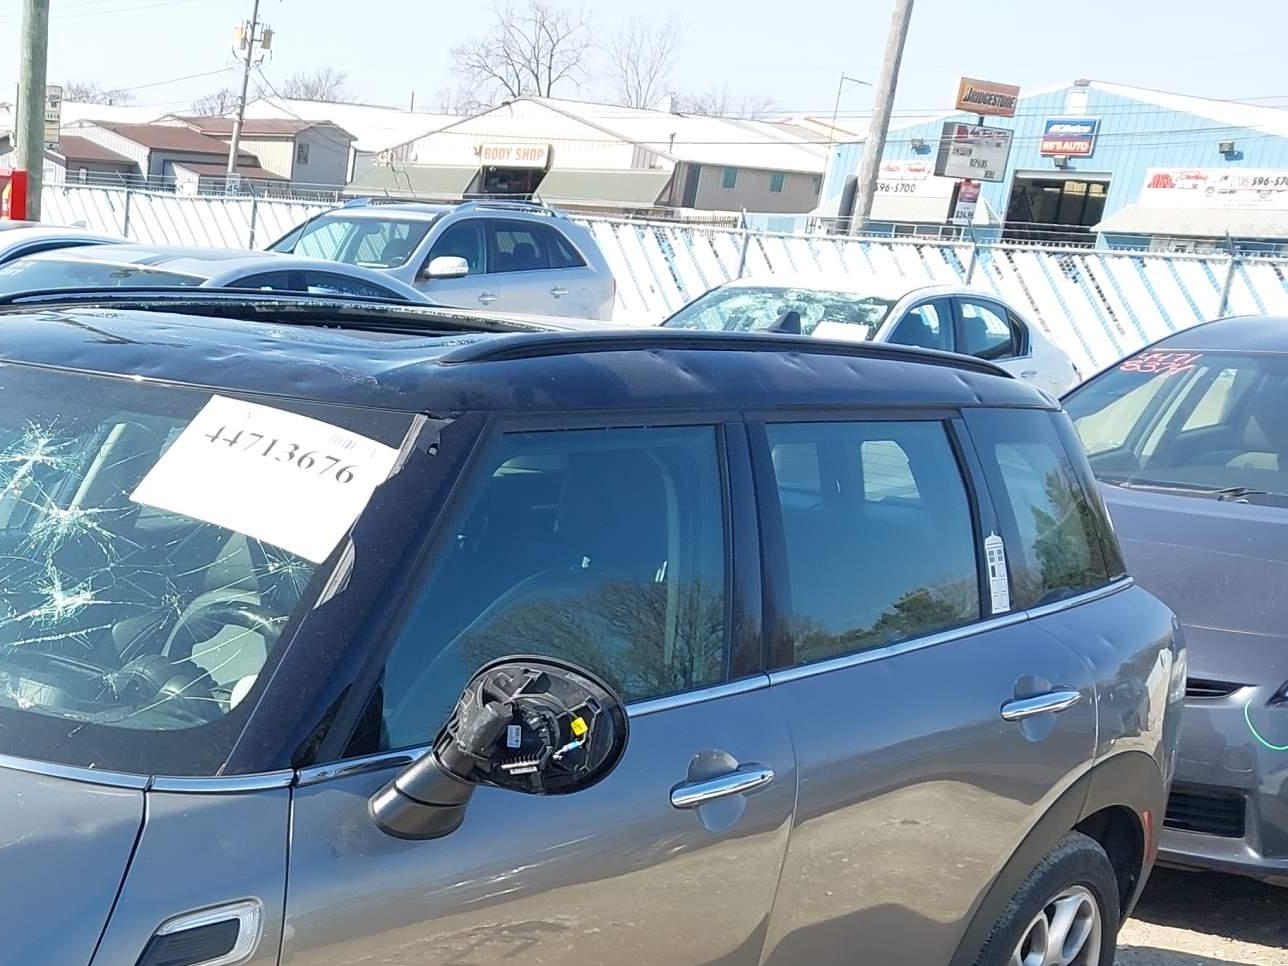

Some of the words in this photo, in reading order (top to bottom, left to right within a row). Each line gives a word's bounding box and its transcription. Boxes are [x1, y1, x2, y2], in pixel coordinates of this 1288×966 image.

[1063, 141, 1090, 152] AUTO
[484, 147, 512, 160] BODY
[515, 148, 544, 160] SHOP
[204, 425, 361, 484] 44713676
